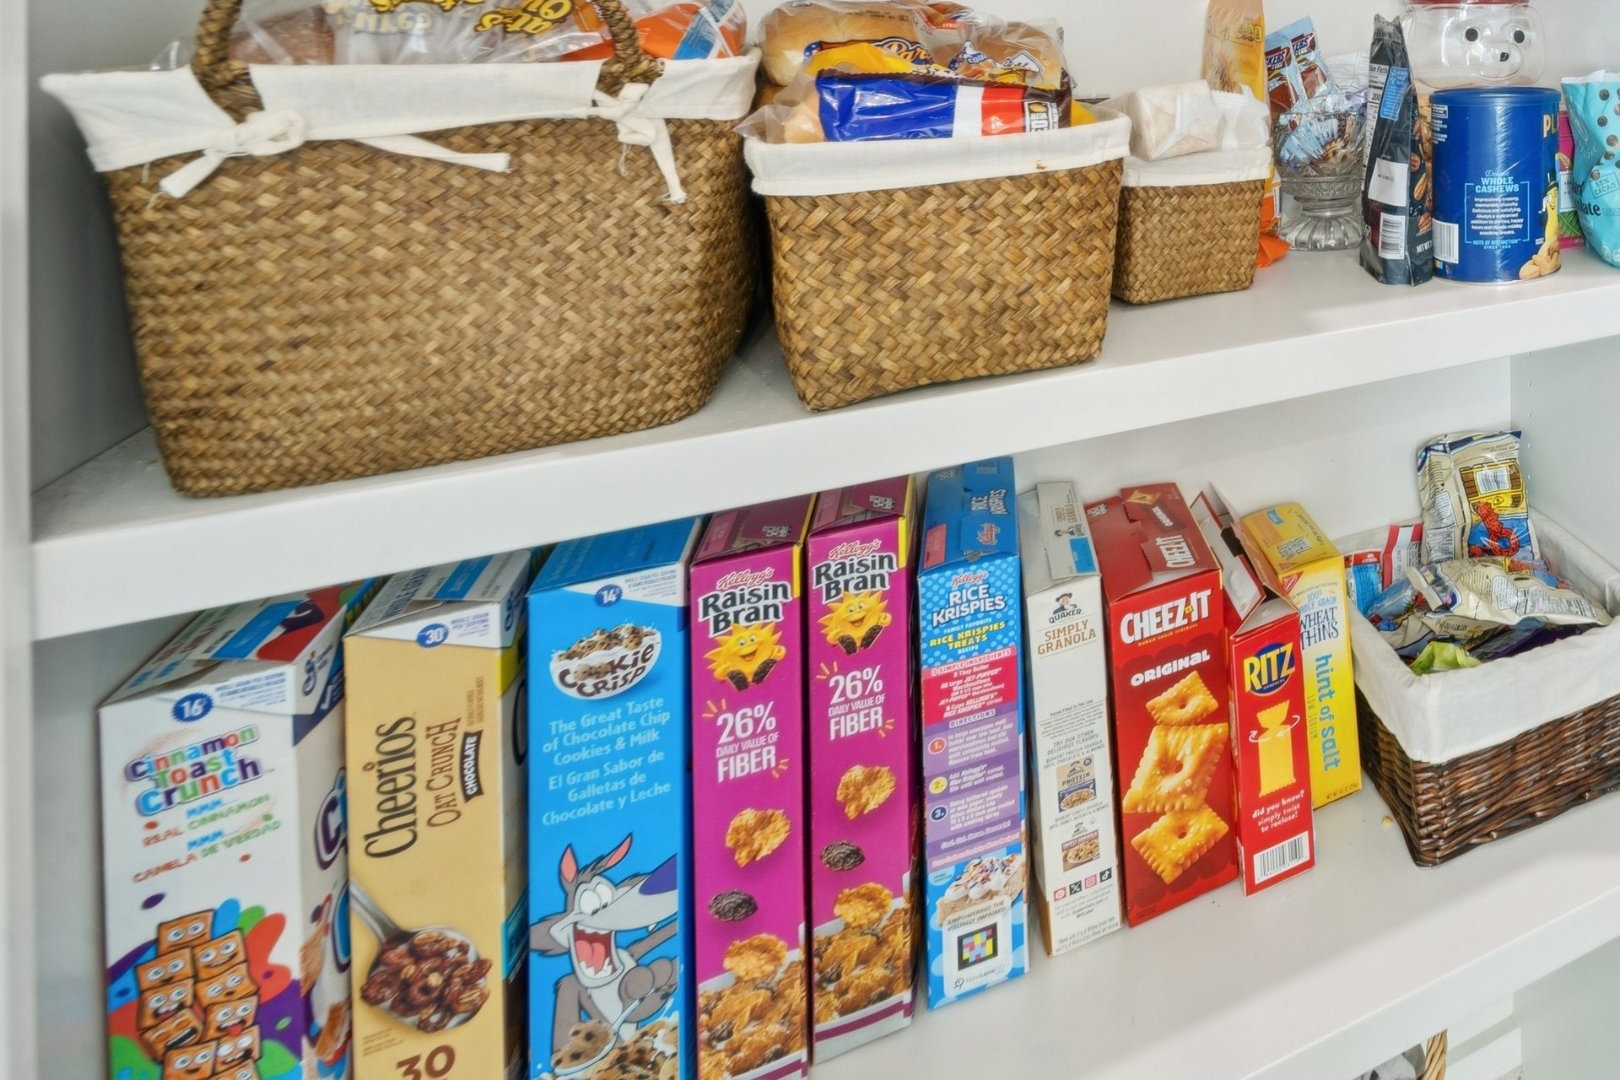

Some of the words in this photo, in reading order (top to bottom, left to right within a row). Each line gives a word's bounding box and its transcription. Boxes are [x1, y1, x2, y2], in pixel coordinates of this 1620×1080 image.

[1475, 184, 1519, 194] CASHEWS
[1481, 177, 1514, 186] WHOLE
[1593, 183, 1616, 196] CACAO
[829, 538, 881, 560] Kellogg's
[717, 567, 774, 590] Kellogg's
[813, 552, 895, 587] Raisin
[701, 582, 790, 620] Raisin
[822, 570, 888, 604] Bran
[949, 584, 990, 606] RICE
[711, 603, 782, 636] Bran
[932, 594, 1007, 628] KRISPIES
[1048, 606, 1083, 625] QUAKER
[1121, 588, 1212, 645] CHEEZ-IT
[1300, 606, 1339, 631] WHEAT
[930, 634, 954, 647] RICE
[957, 621, 1006, 639] KRISPIES
[948, 634, 988, 650] TREATS
[1037, 629, 1098, 656] GRANOLA
[1044, 618, 1090, 643] SIMPLY
[1300, 623, 1340, 651] THINS
[1243, 641, 1297, 693] RITZ
[1315, 653, 1335, 703] hint
[828, 665, 883, 705] 26%
[549, 719, 577, 736] The
[580, 708, 622, 731] Great
[626, 696, 666, 717] Taste
[828, 702, 850, 717] DAILY
[851, 696, 874, 712] VALUE
[875, 692, 886, 705] OF
[950, 709, 996, 728] DIRECTIONS
[1319, 705, 1335, 721] of
[541, 737, 561, 754] of
[562, 721, 637, 748] Chocolate
[640, 710, 672, 728] Chip
[716, 701, 777, 745] 26%
[829, 706, 883, 741] FIBER
[129, 726, 256, 779] Cinnamon
[426, 716, 463, 786] CRUNCH
[553, 743, 612, 766] Cookies
[615, 737, 627, 752] &
[630, 728, 661, 748] Milk
[716, 741, 738, 758] DAILY
[740, 735, 766, 752] VALUE
[767, 732, 780, 745] OF
[1321, 726, 1341, 772] salt
[154, 747, 235, 789] Toast
[464, 734, 478, 796] CHOCOLATE
[548, 775, 563, 791] El
[566, 767, 601, 787] Gran
[603, 755, 645, 778] Sabor
[648, 749, 666, 764] de
[716, 745, 777, 781] FIBER
[1062, 772, 1091, 787] PROTEIN
[138, 756, 261, 813] Crunch
[364, 715, 418, 860] Cheerios
[568, 778, 627, 803] Galletas
[629, 772, 647, 787] de
[427, 785, 462, 829] OAT
[541, 799, 616, 826] Chocolate
[618, 795, 628, 809] y
[630, 780, 672, 803] Leche
[1252, 806, 1267, 820] did
[1266, 802, 1281, 818] you
[1281, 790, 1305, 811] know?
[1258, 812, 1282, 828] simply
[1282, 802, 1301, 817] twist
[1260, 823, 1269, 833] to
[1270, 810, 1299, 832] reclose!
[396, 1044, 457, 1080] 30
